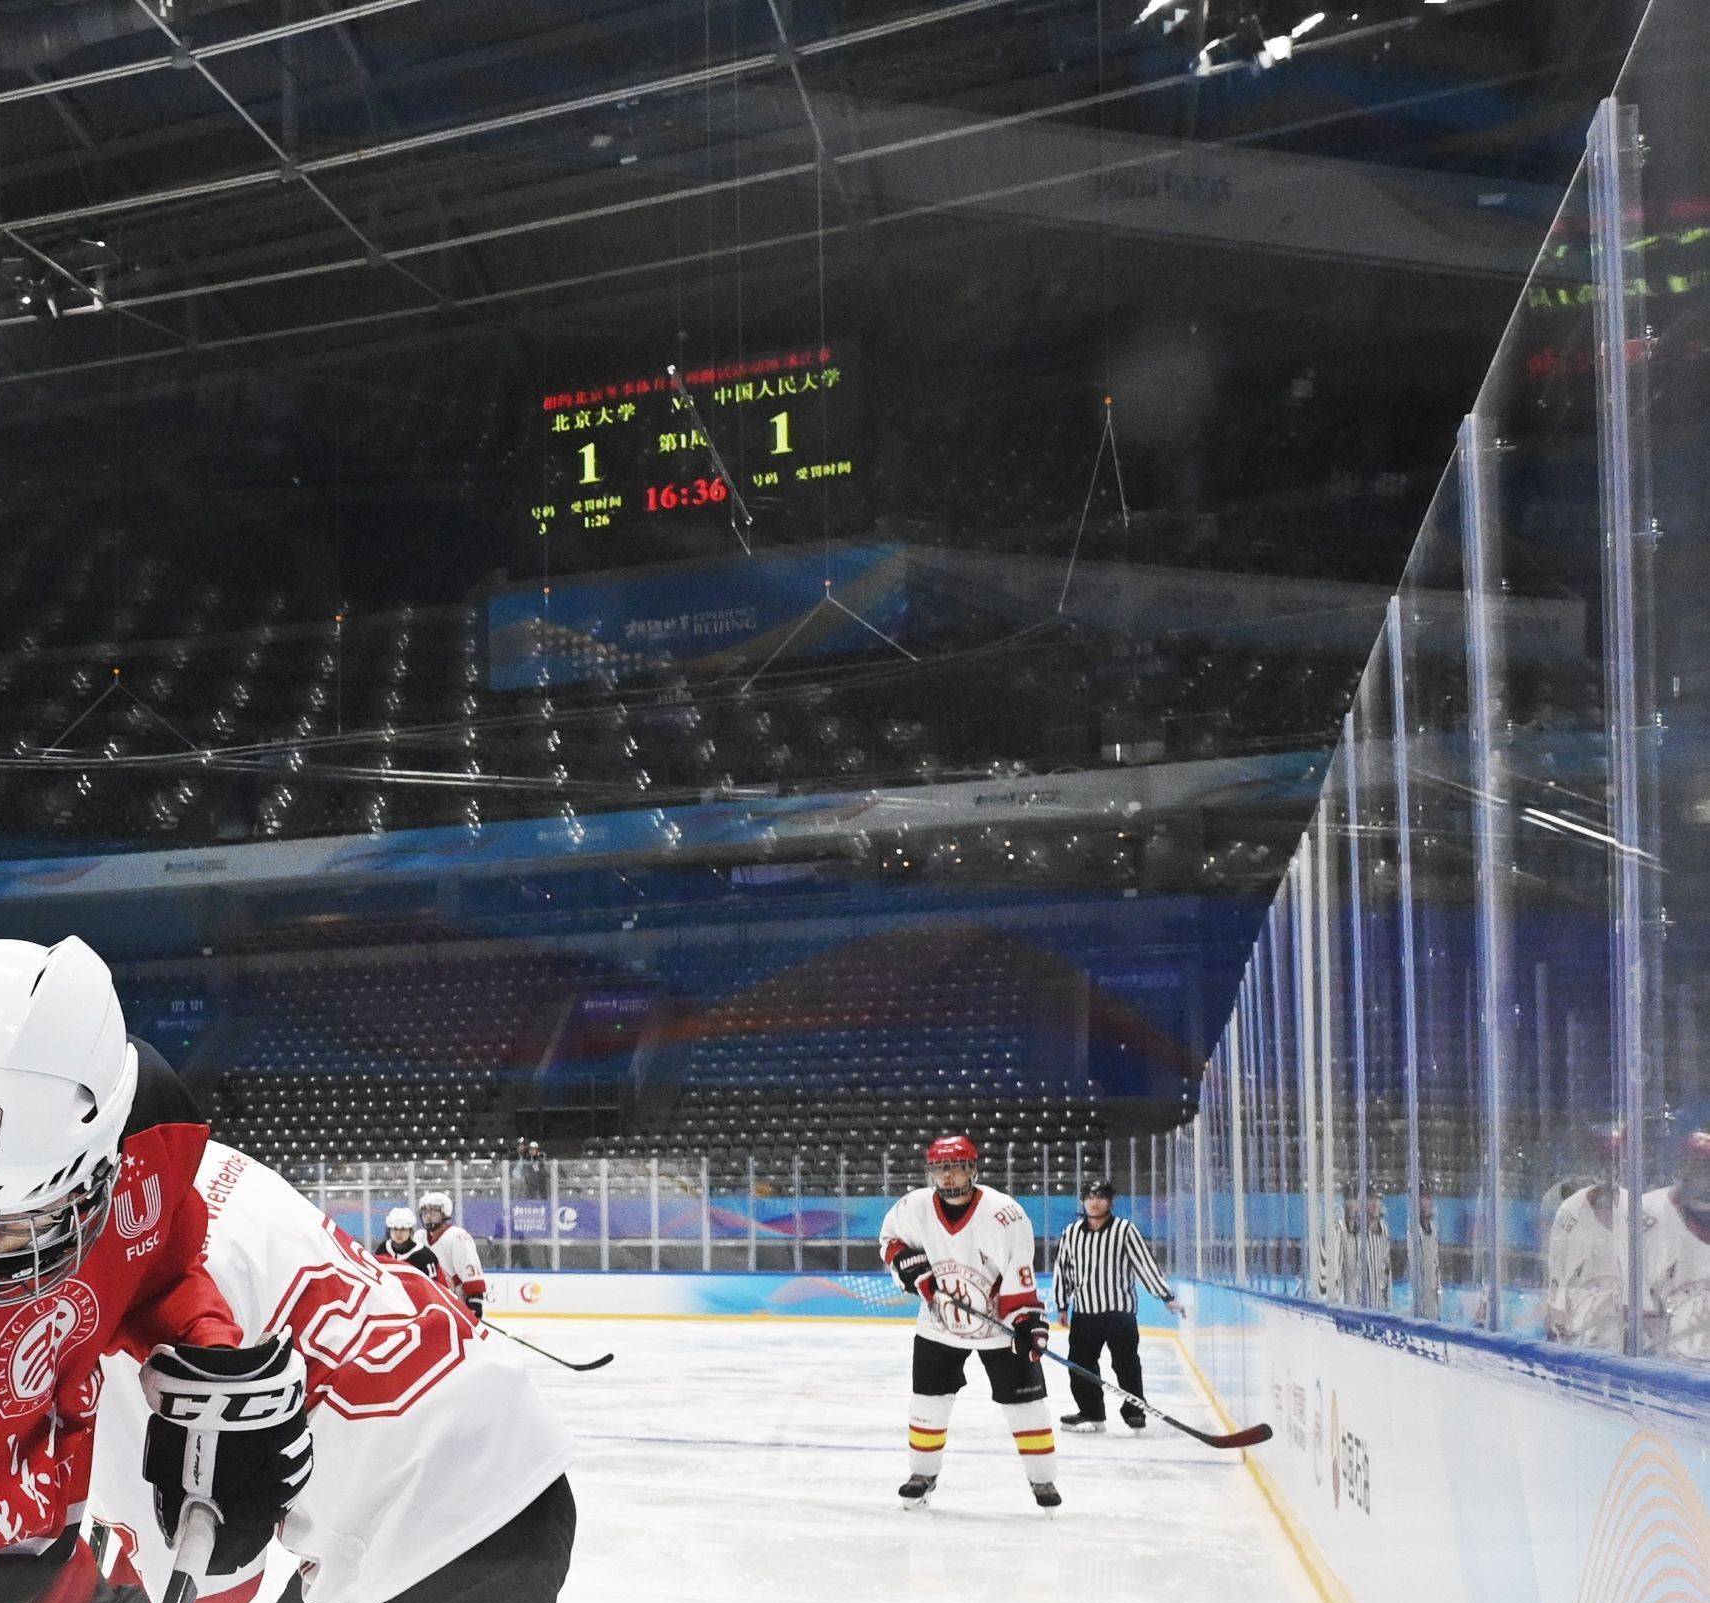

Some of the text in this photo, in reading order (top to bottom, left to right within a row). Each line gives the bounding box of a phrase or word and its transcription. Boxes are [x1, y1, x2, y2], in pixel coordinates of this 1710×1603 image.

[713, 368, 841, 406] 中国人民大学
[551, 402, 637, 433] 北京大学
[768, 410, 794, 456] 1
[577, 441, 601, 485] 1
[752, 460, 853, 488] 号码 受罚时间
[570, 496, 622, 515] 受罚时间
[645, 477, 729, 513] 16:36
[124, 1229, 161, 1264] FUSC
[1017, 1266, 1033, 1288] 8
